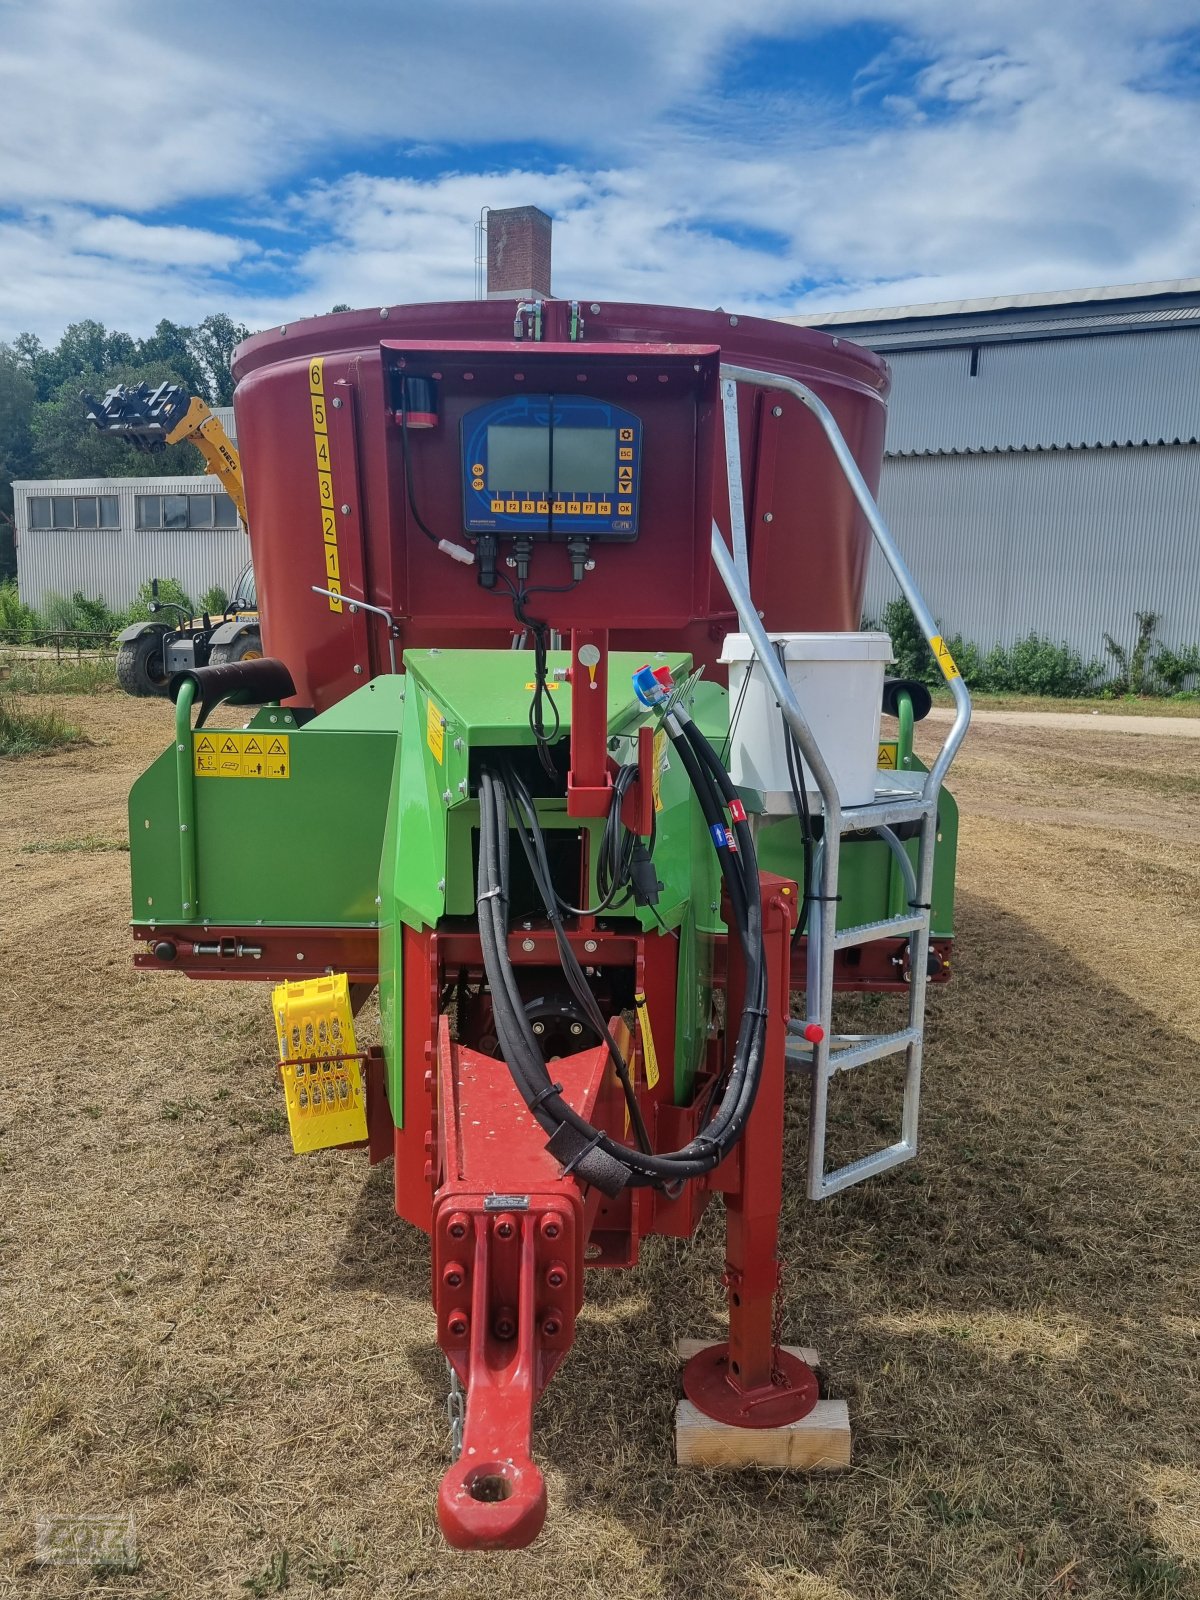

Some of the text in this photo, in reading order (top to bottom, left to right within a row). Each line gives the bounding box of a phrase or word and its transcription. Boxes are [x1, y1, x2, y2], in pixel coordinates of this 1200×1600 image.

[311, 365, 321, 385] 6
[315, 405, 324, 424] 5
[219, 445, 237, 470] DIECI
[318, 443, 328, 462] 4
[321, 481, 331, 499] 3
[324, 517, 334, 536] 2
[329, 553, 336, 571] 1
